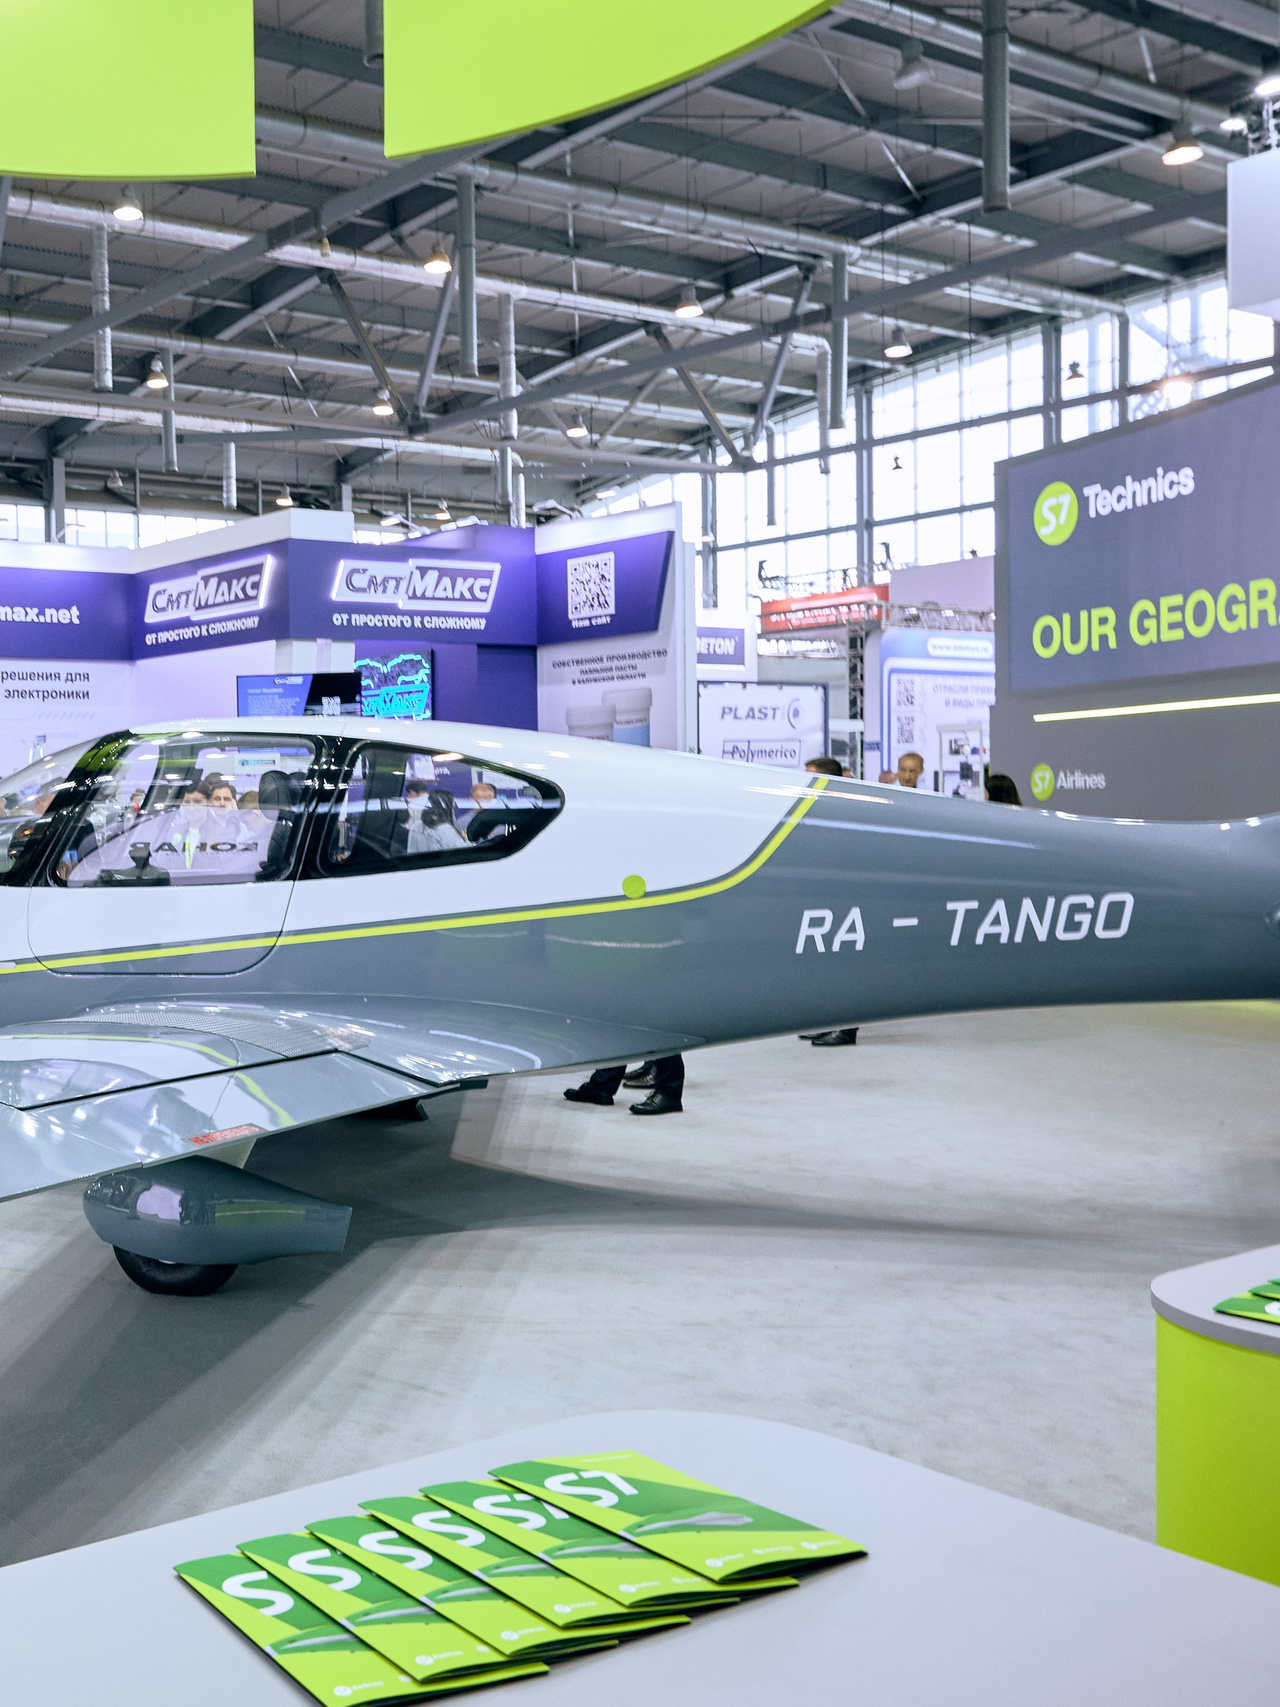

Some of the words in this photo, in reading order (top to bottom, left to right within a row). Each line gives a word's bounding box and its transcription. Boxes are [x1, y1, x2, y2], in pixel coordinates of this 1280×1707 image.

[1039, 492, 1072, 536] S7
[1083, 466, 1196, 519] Technics
[157, 625, 201, 644] ПРОСТОГО
[332, 612, 350, 626] ОТ
[351, 613, 412, 628] ПРОСТОГО
[414, 616, 423, 628] К
[423, 616, 487, 631] СЛОЖНОМУ
[1032, 606, 1118, 659] OUR
[1129, 577, 1280, 646] GEOGR
[0, 670, 62, 684] решения
[65, 671, 91, 684] для
[4, 688, 91, 702] электроники
[1034, 771, 1051, 794] S7
[1056, 769, 1107, 791] Airlines
[795, 906, 866, 954] RA
[945, 892, 1135, 946] TANGO
[544, 1470, 639, 1509] S7
[411, 1510, 486, 1547] S
[287, 1548, 362, 1592] S
[357, 1530, 434, 1571] S
[221, 1570, 295, 1617] S
